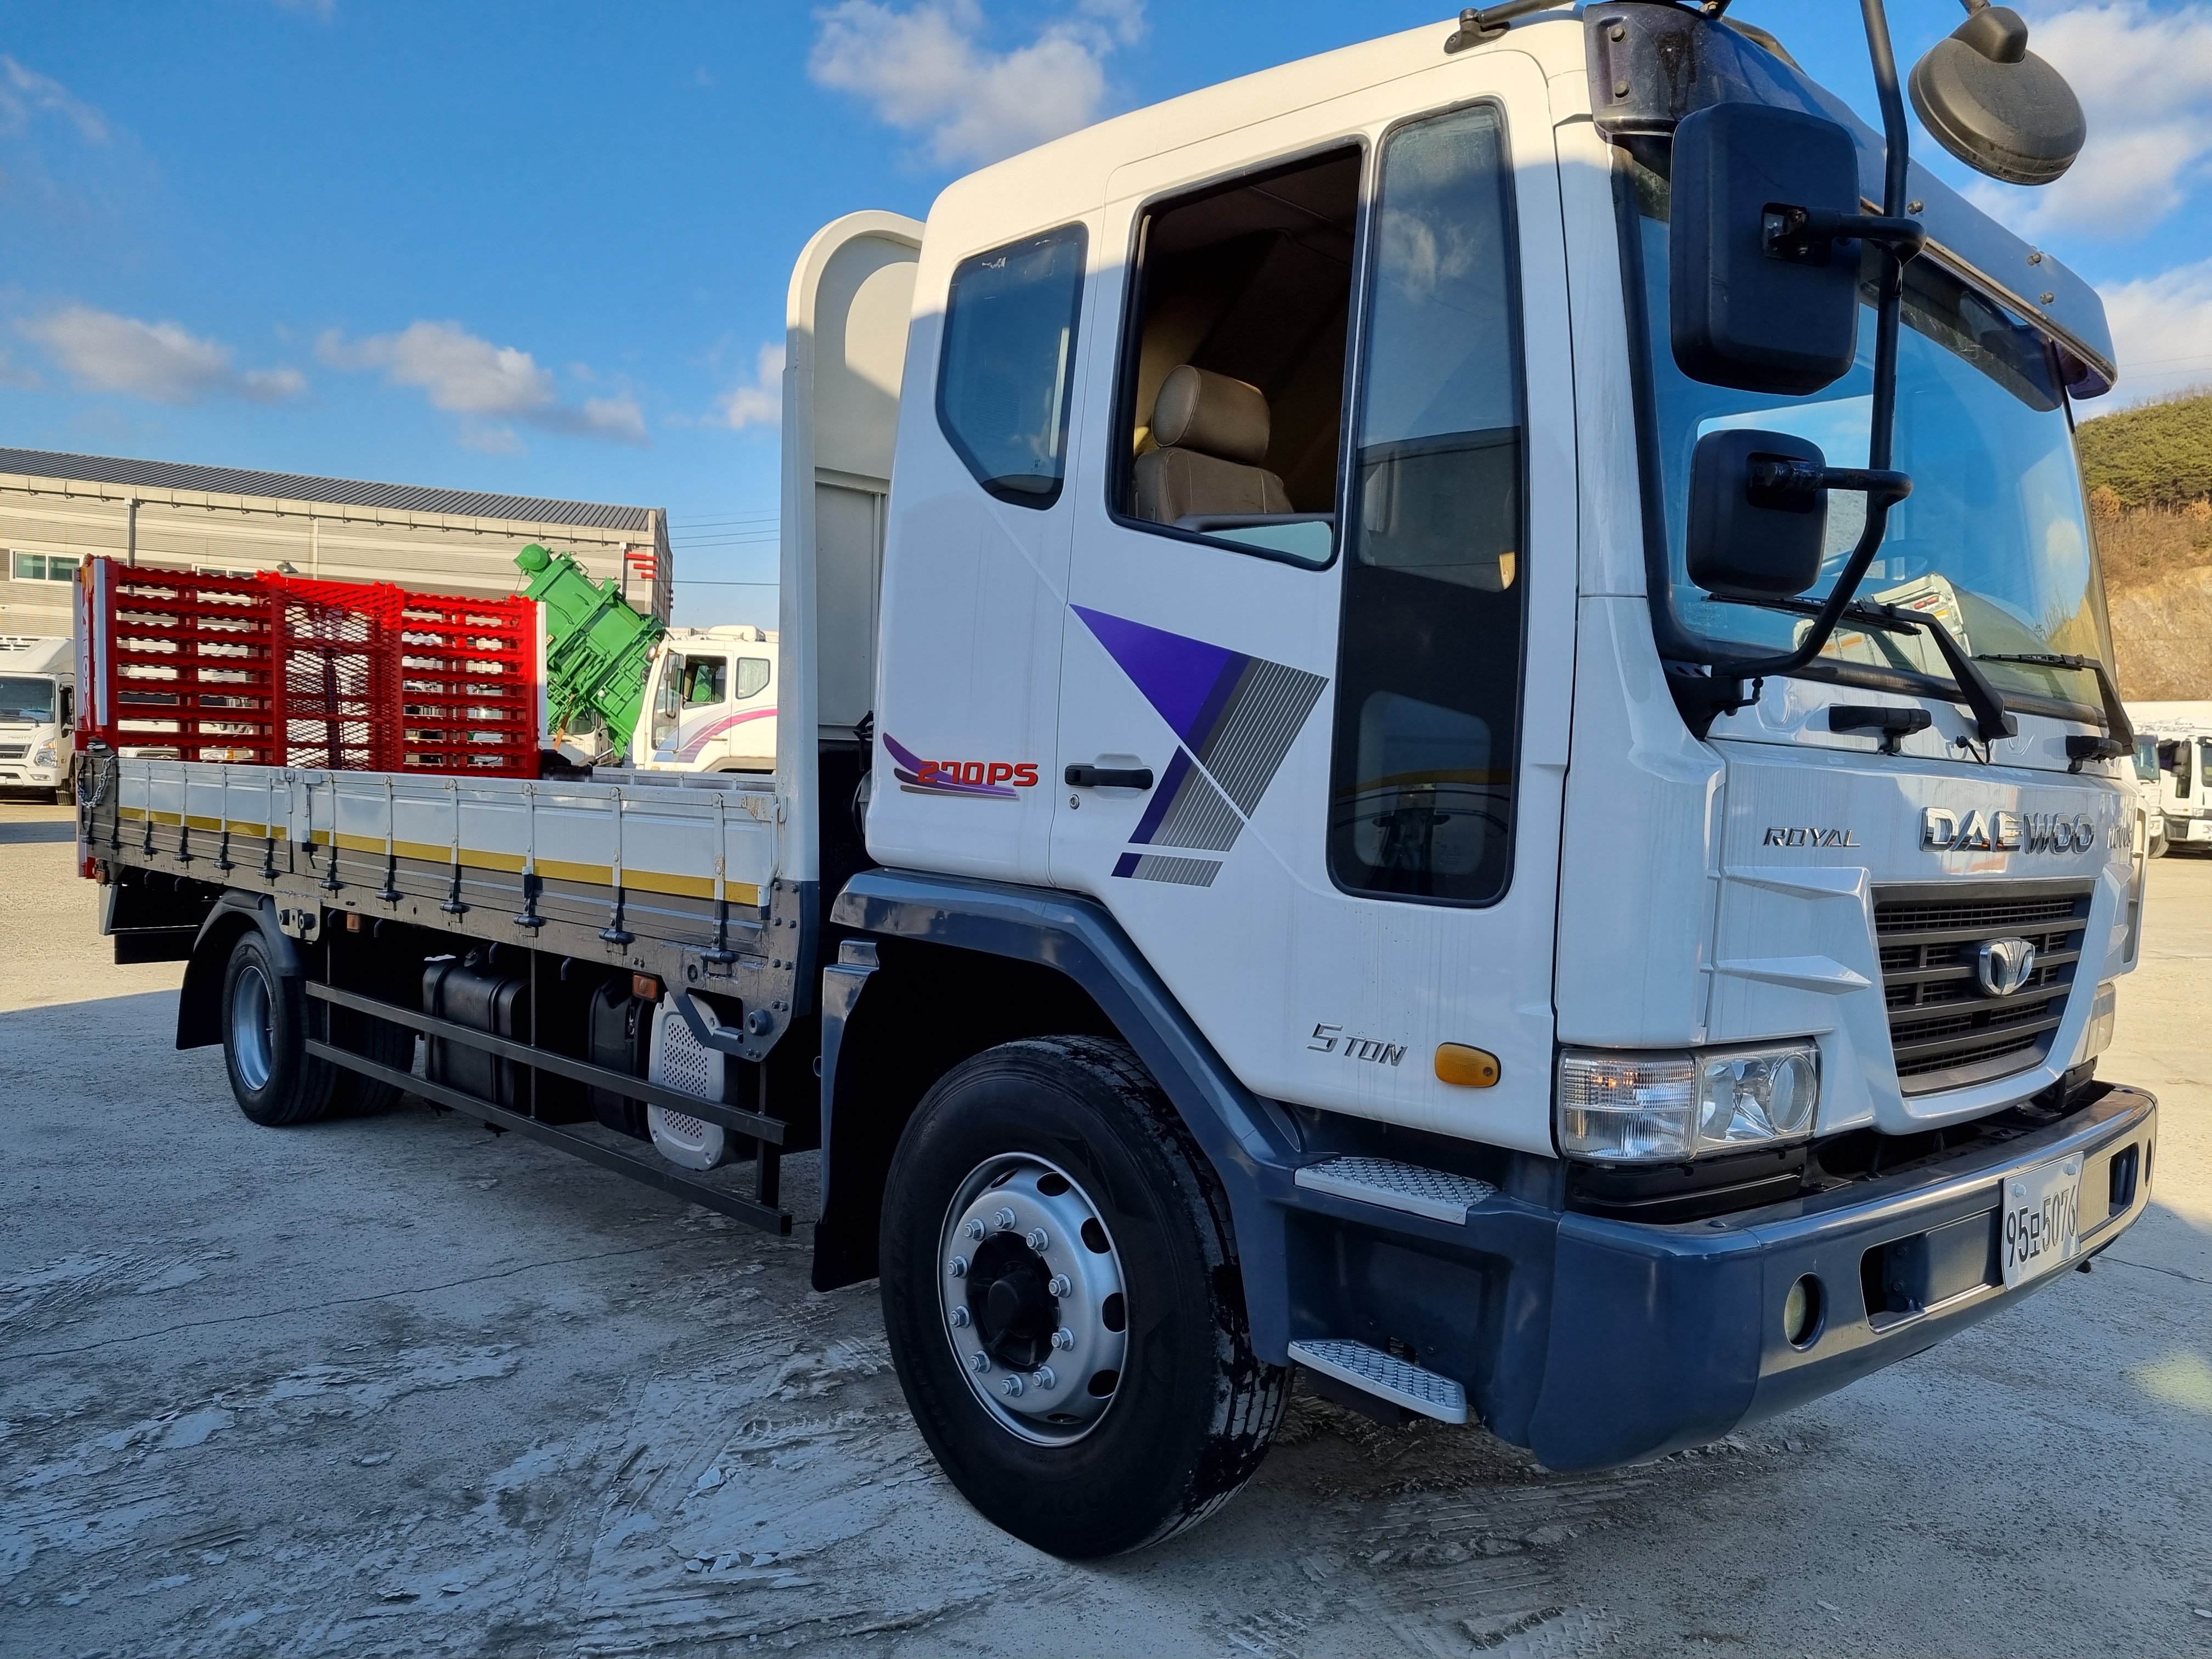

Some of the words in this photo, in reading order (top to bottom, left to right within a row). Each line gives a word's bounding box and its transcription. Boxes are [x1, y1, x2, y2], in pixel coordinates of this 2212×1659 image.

[917, 760, 1039, 787] 270PS
[1762, 826, 1861, 848] ROYAL
[1919, 806, 2095, 855] DAEWOO
[1306, 1021, 1344, 1053] 5
[1344, 1034, 1409, 1067] TON
